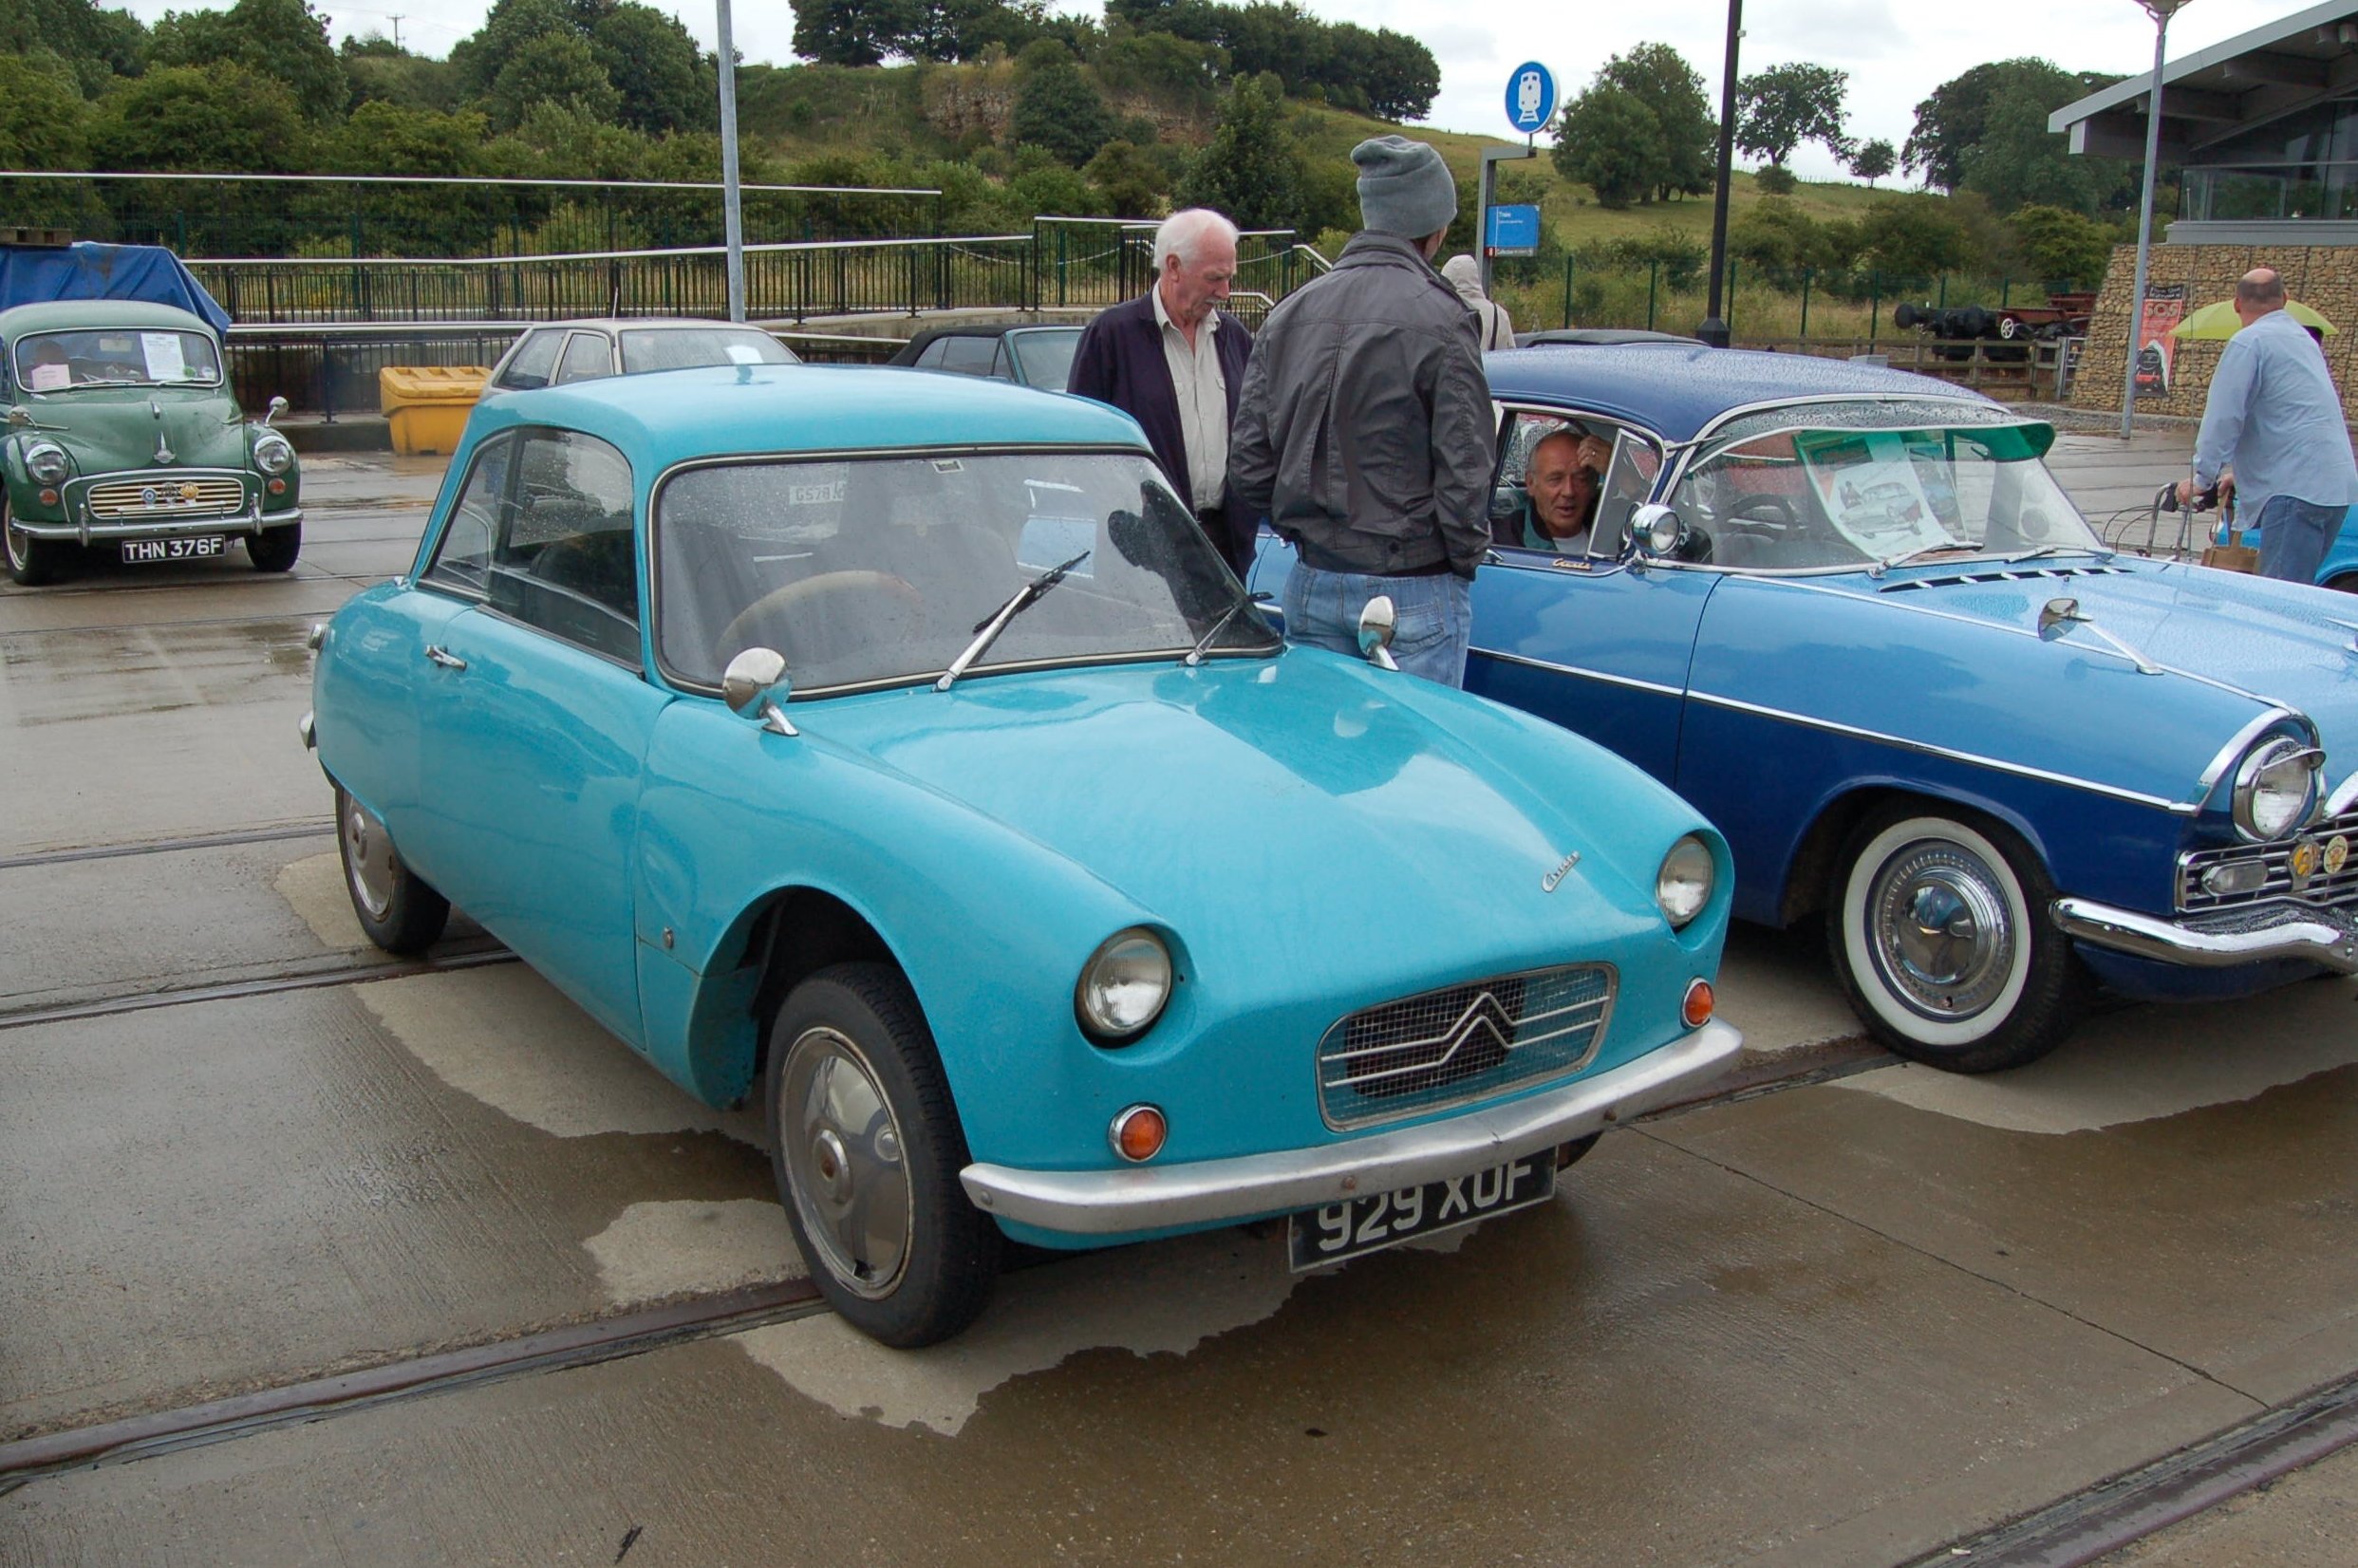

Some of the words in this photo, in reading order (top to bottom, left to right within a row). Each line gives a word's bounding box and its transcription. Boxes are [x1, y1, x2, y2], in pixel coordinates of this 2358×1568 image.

[2146, 303, 2179, 318] SOS
[124, 541, 166, 560] THN
[170, 537, 222, 556] 376F
[1317, 1185, 1423, 1251] 929
